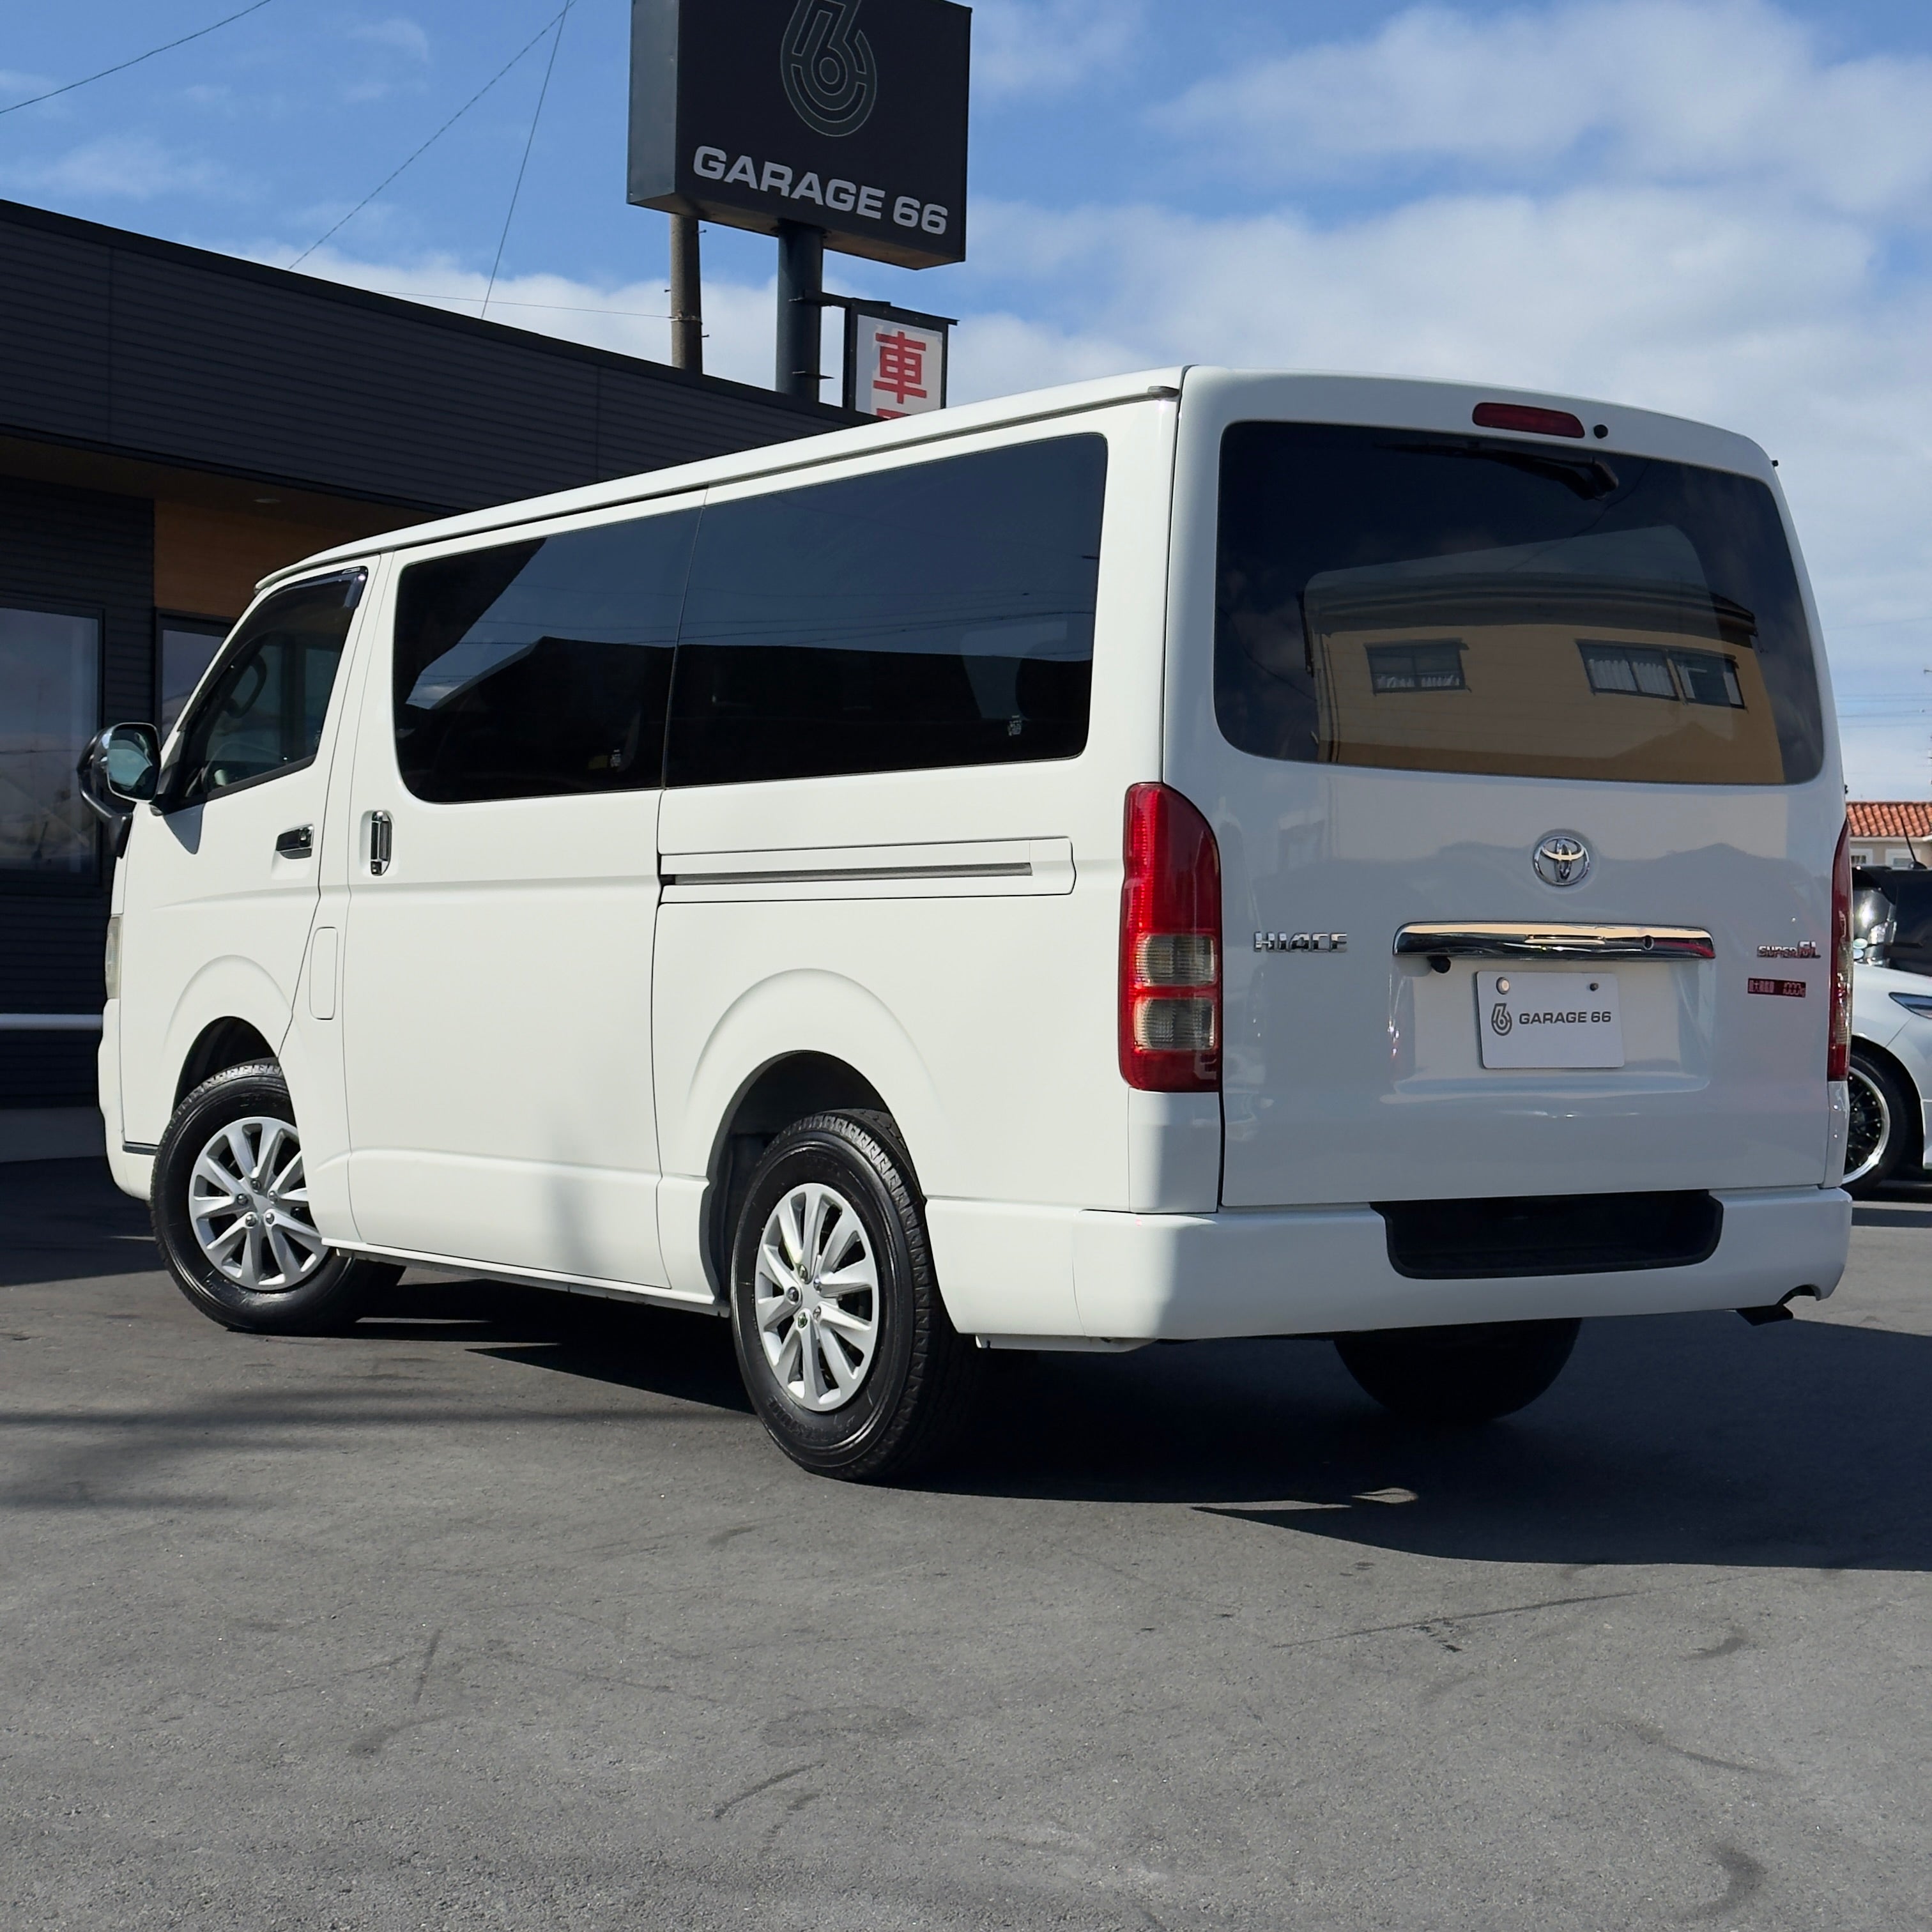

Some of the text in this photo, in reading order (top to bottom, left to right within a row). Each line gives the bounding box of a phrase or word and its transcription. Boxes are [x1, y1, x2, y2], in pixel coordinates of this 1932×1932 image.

[693, 146, 949, 236] GARAGE 66
[873, 331, 927, 419] 車
[1254, 931, 1347, 953] HIACE
[1519, 1011, 1612, 1025] GARAGE 66
